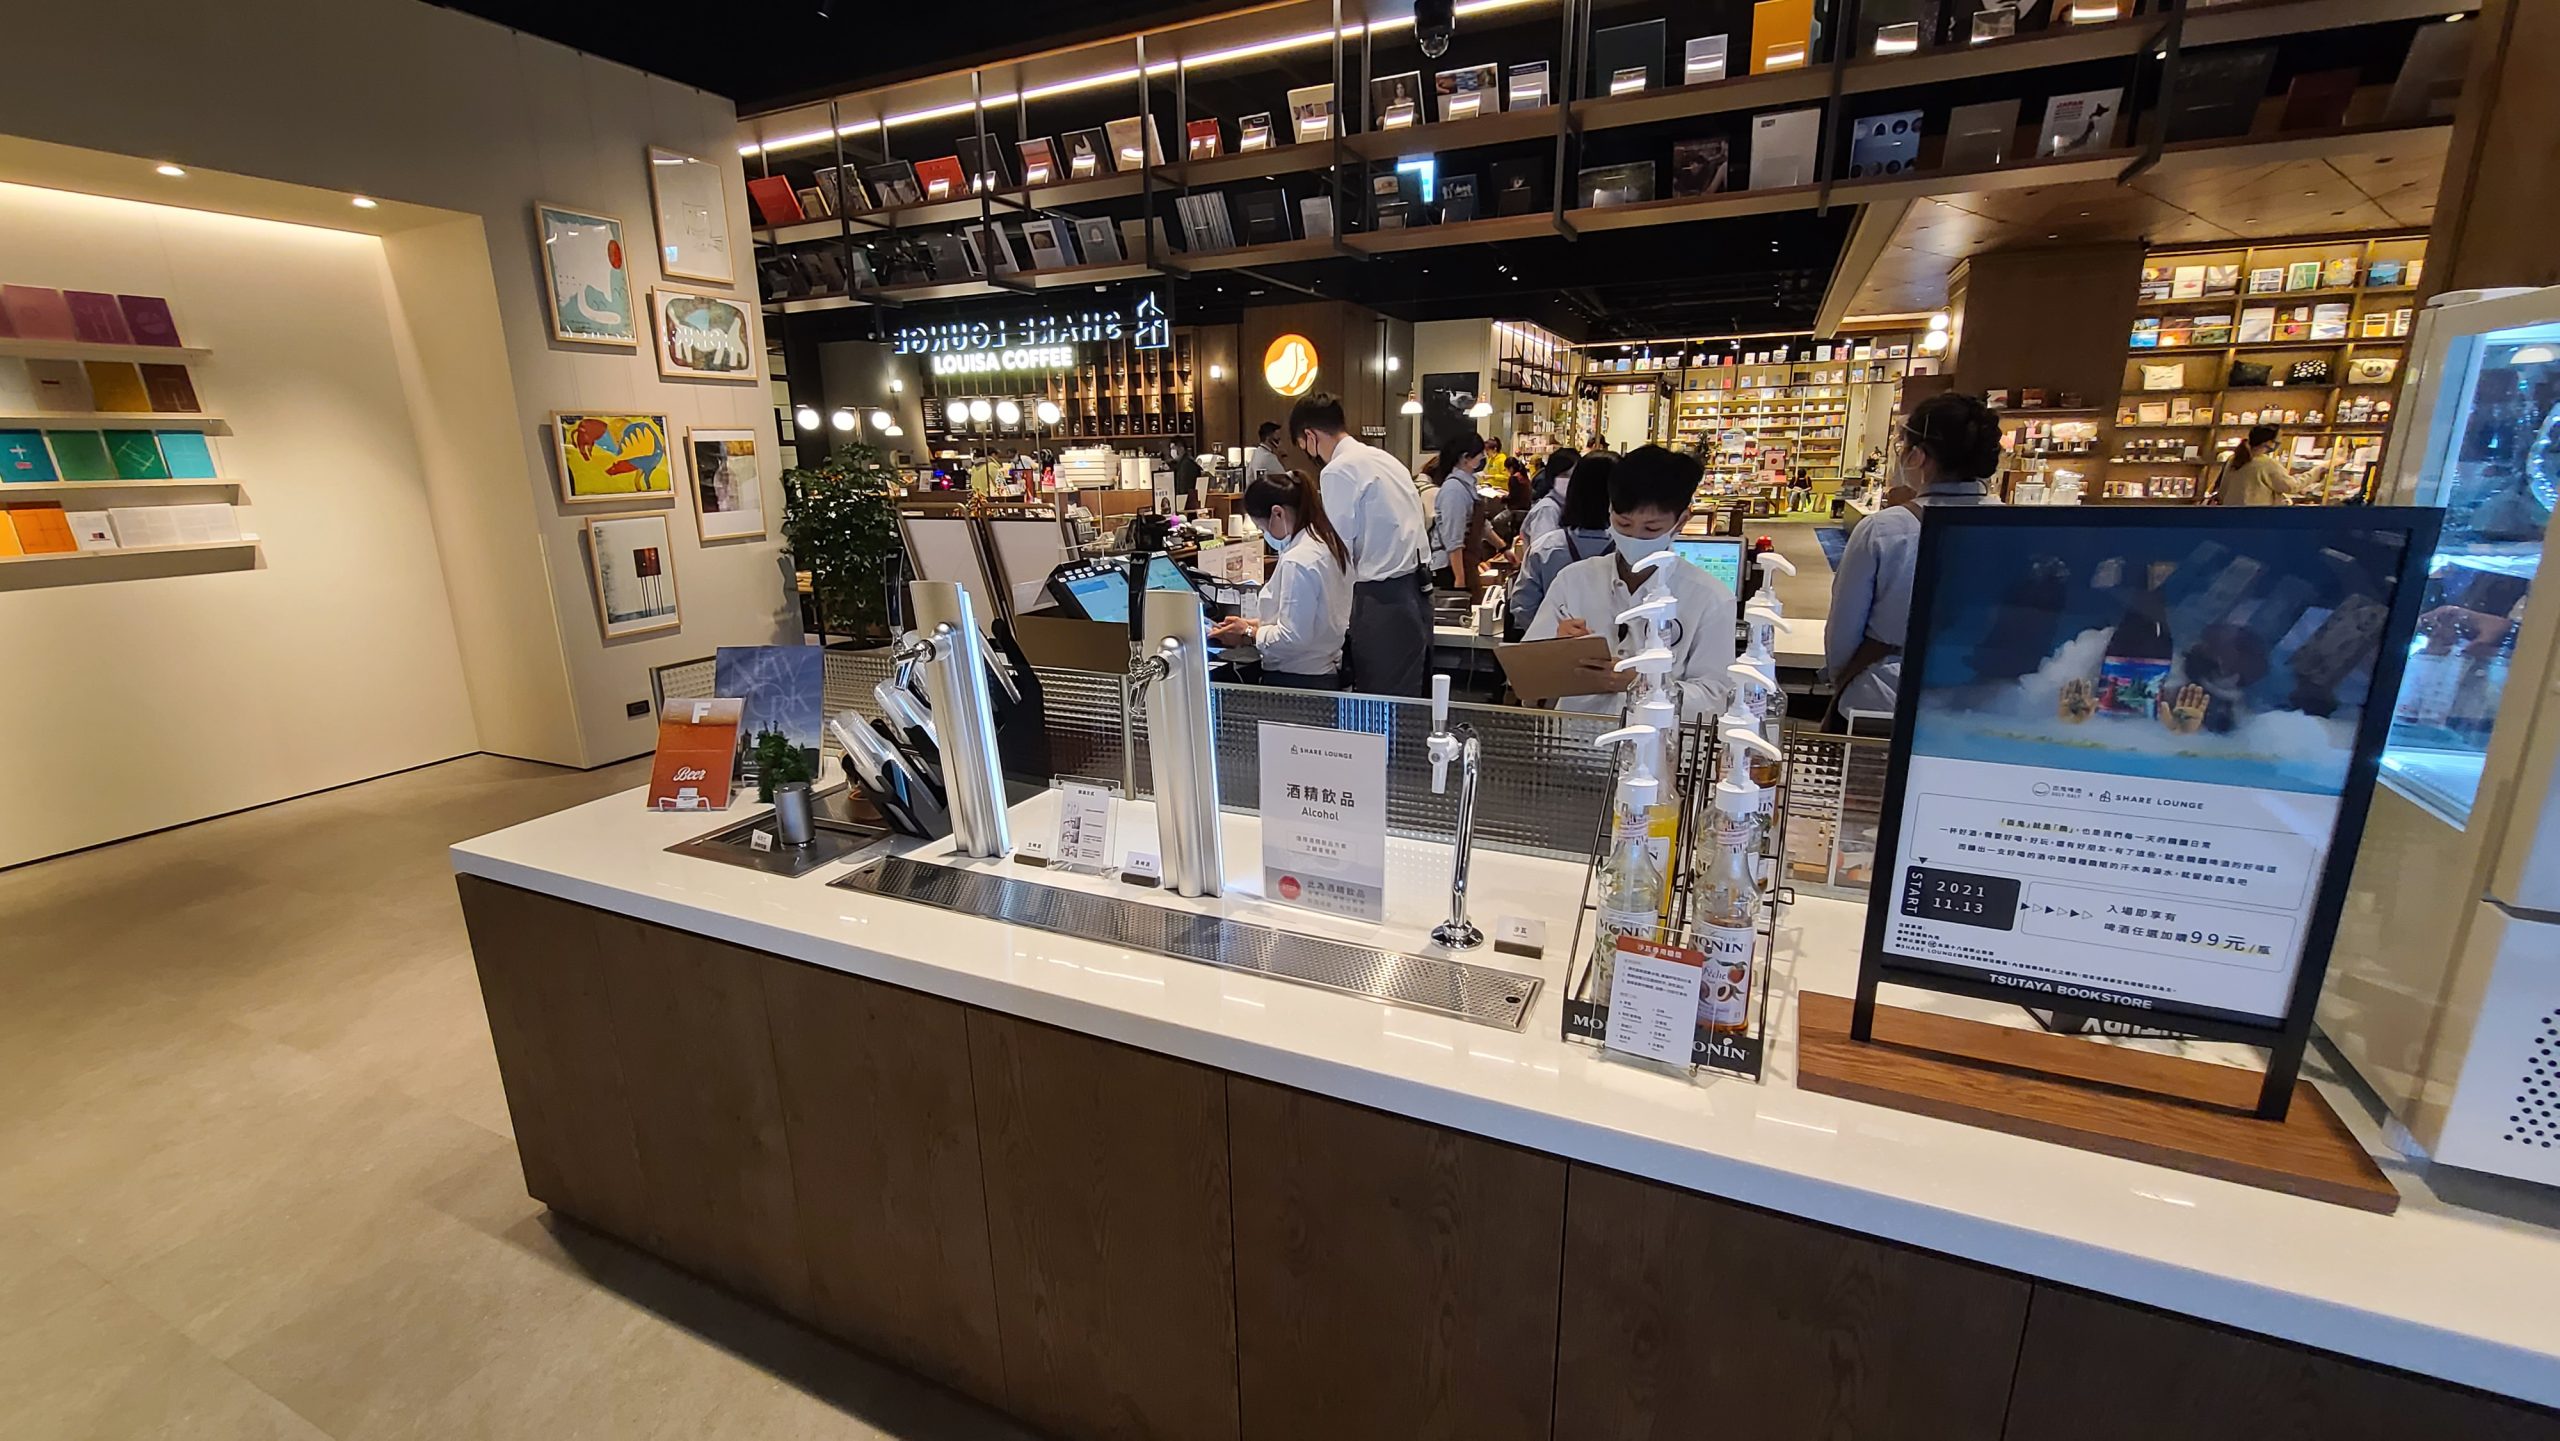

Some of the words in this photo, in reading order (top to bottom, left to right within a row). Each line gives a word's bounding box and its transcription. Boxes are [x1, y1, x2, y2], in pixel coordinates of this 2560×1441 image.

[934, 353, 1000, 375] LOUISA
[1002, 347, 1073, 370] COFFEE
[1300, 747, 1322, 756] SHARE
[1324, 750, 1353, 760] LOUNGE
[673, 766, 707, 782] Beer
[1286, 783, 1355, 808] 酒精飲品
[2115, 794, 2152, 804] SHARE
[2156, 799, 2204, 810] LOUNGE
[1301, 806, 1340, 821] Alcohol
[1906, 871, 1923, 914] START
[1936, 881, 1985, 898] 2021
[1932, 897, 1984, 914] 11.13
[2106, 904, 2177, 922] 入場即享有
[1989, 973, 2053, 993] TSUTAYA
[2056, 985, 2153, 1010] BOOKSTORE
